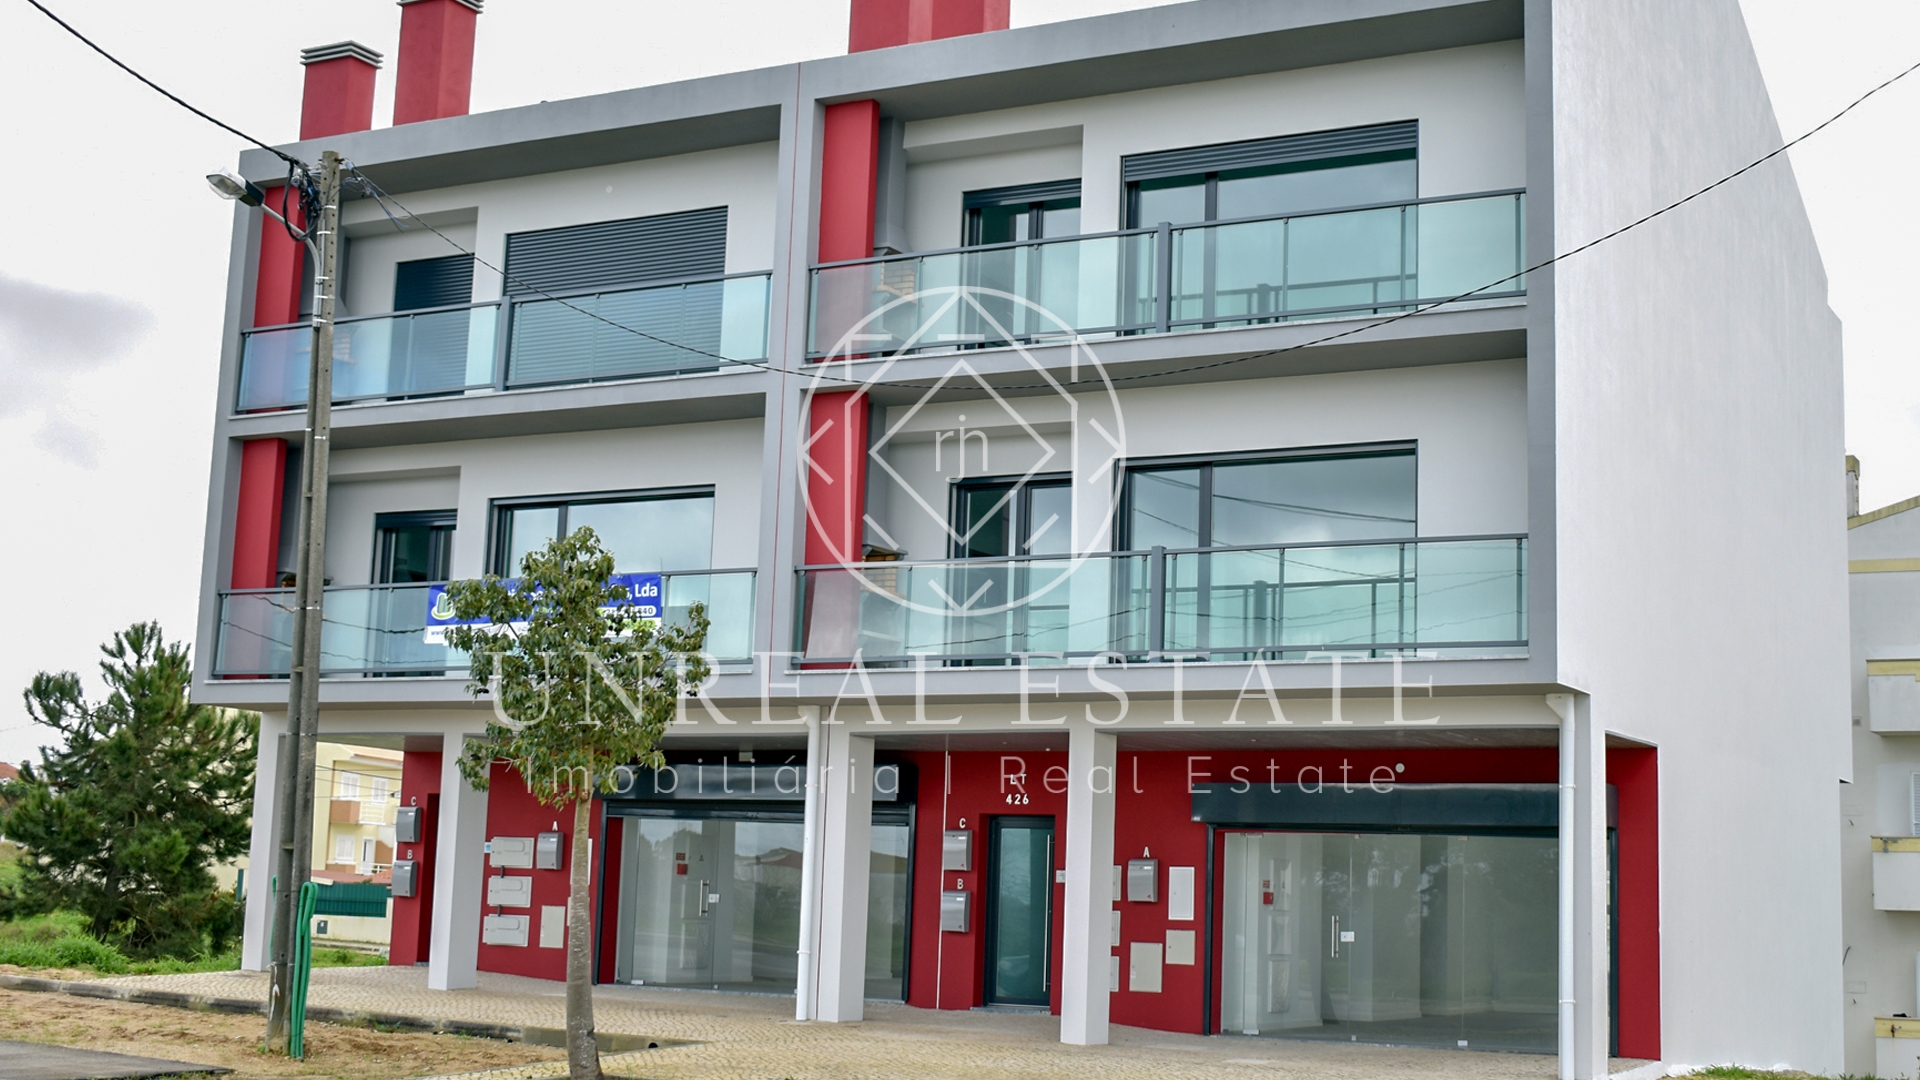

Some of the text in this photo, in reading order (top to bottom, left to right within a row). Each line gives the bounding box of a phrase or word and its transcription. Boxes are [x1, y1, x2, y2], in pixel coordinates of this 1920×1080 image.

[635, 582, 658, 597] Lda
[1010, 773, 1026, 785] LT
[411, 796, 417, 806] C
[1006, 793, 1029, 805] 426
[552, 821, 558, 831] A
[959, 818, 966, 829] C
[407, 849, 413, 859] B
[1143, 847, 1150, 858] A
[957, 879, 964, 890] B
